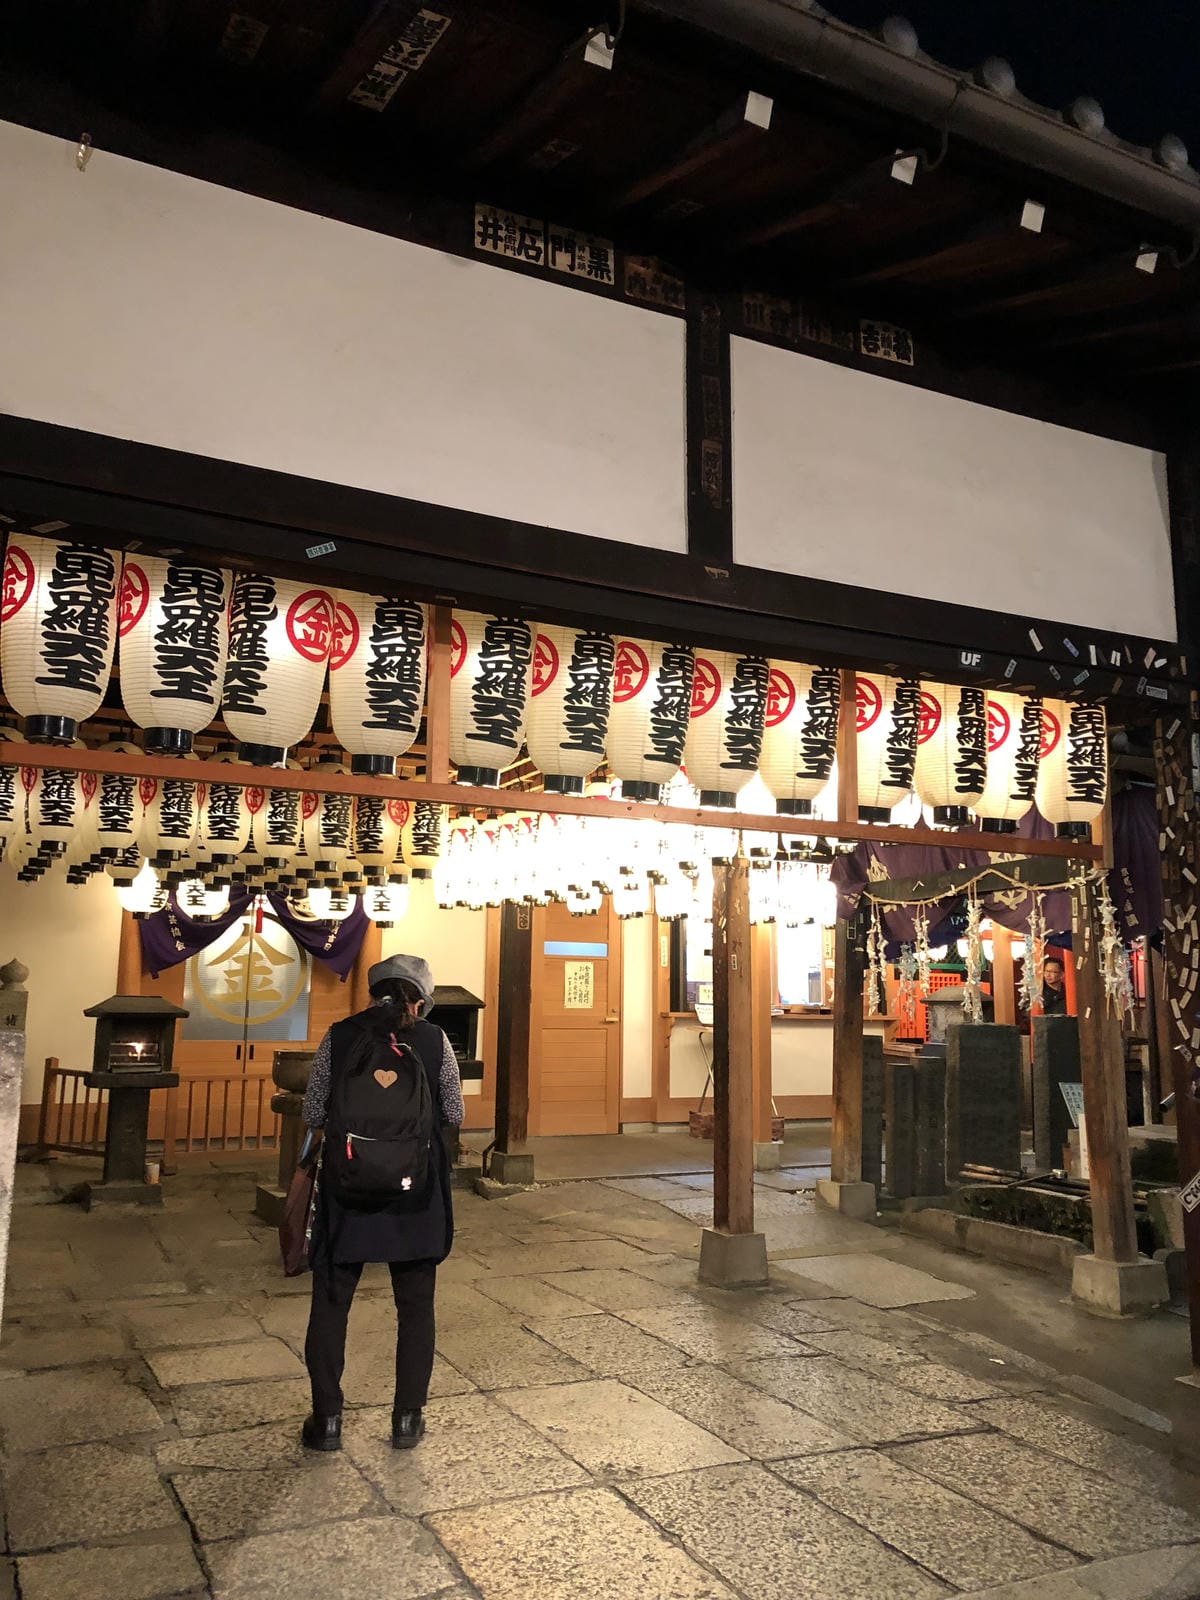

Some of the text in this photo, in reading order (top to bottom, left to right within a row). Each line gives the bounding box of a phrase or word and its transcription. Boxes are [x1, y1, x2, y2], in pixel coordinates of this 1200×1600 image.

[35, 543, 115, 695] 毘羅天王
[361, 598, 425, 733] 毘羅天王
[961, 651, 982, 666] UF
[465, 616, 532, 749] 毘羅天王
[559, 630, 616, 754] 毘羅天王
[643, 643, 696, 765] 毘羅天王
[719, 654, 771, 771] 毘羅天王
[796, 664, 841, 780] 毘羅天王
[881, 679, 921, 790] 毘羅天王
[1066, 699, 1106, 805] 毘羅天王
[207, 923, 296, 1001] 金
